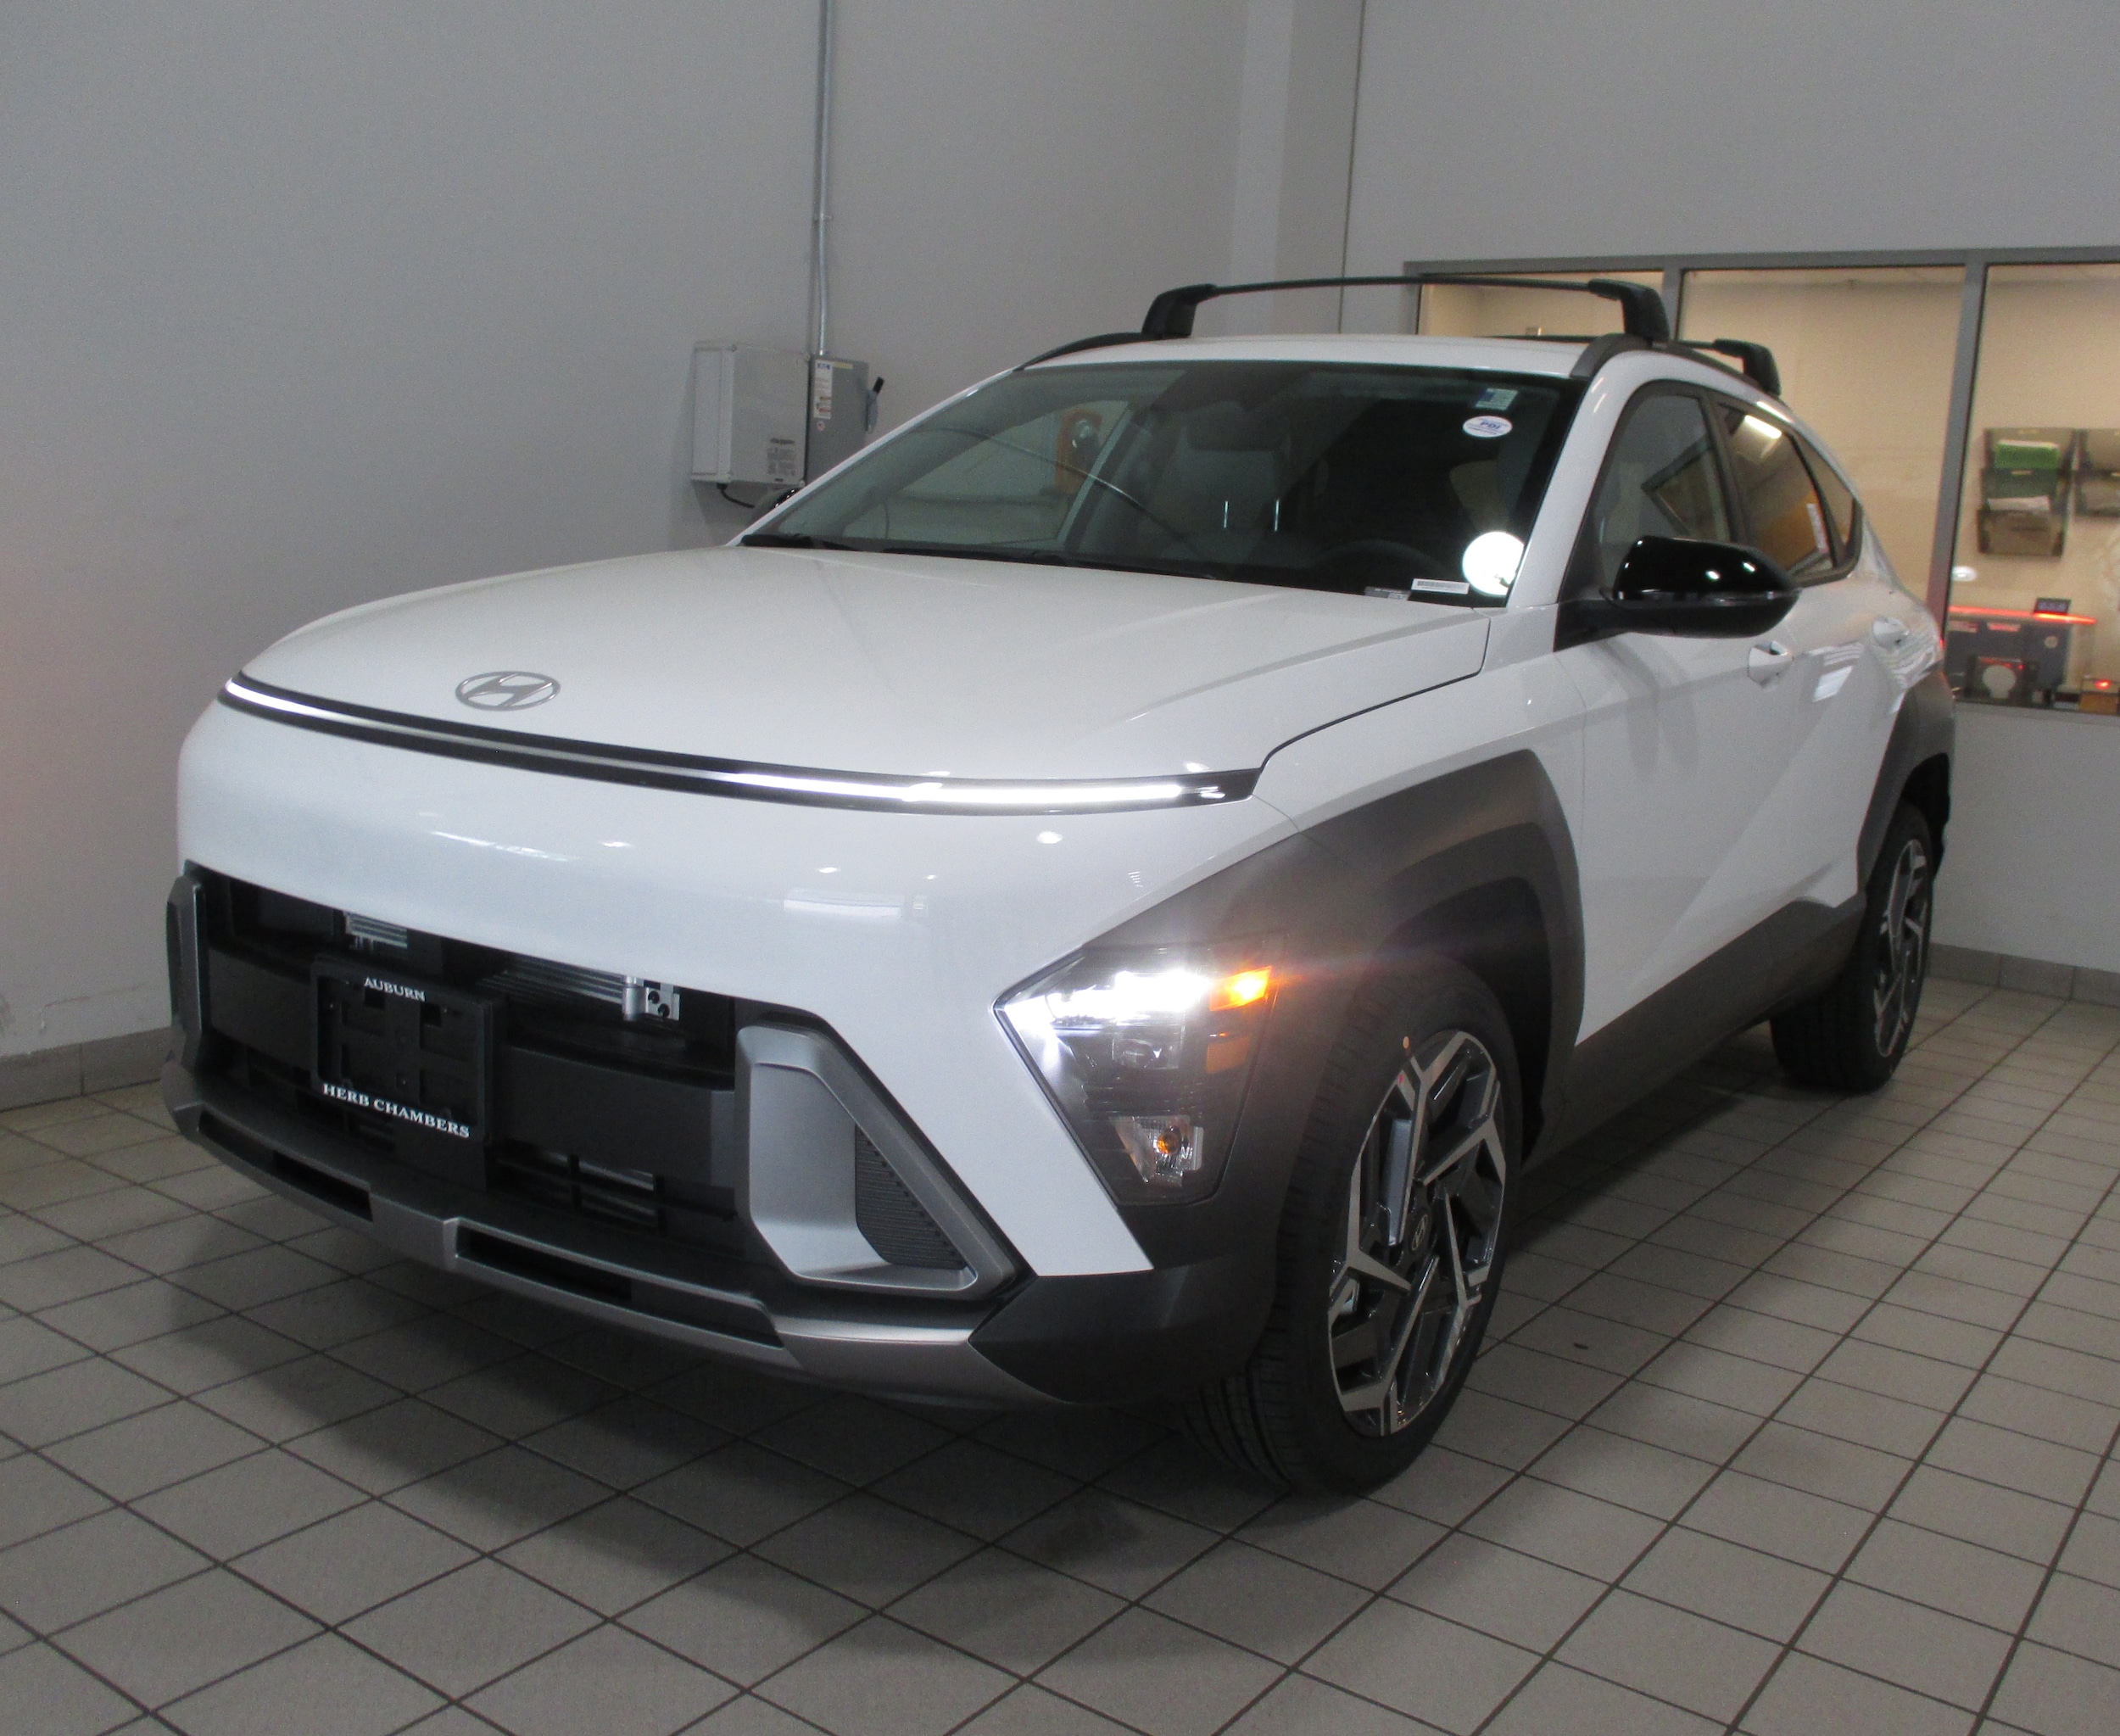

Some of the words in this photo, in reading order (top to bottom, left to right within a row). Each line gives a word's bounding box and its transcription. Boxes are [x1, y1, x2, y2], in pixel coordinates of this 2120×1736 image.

[364, 977, 426, 1002] AUBURN
[323, 1083, 370, 1107] HERB
[373, 1099, 470, 1138] CHAMBERS
